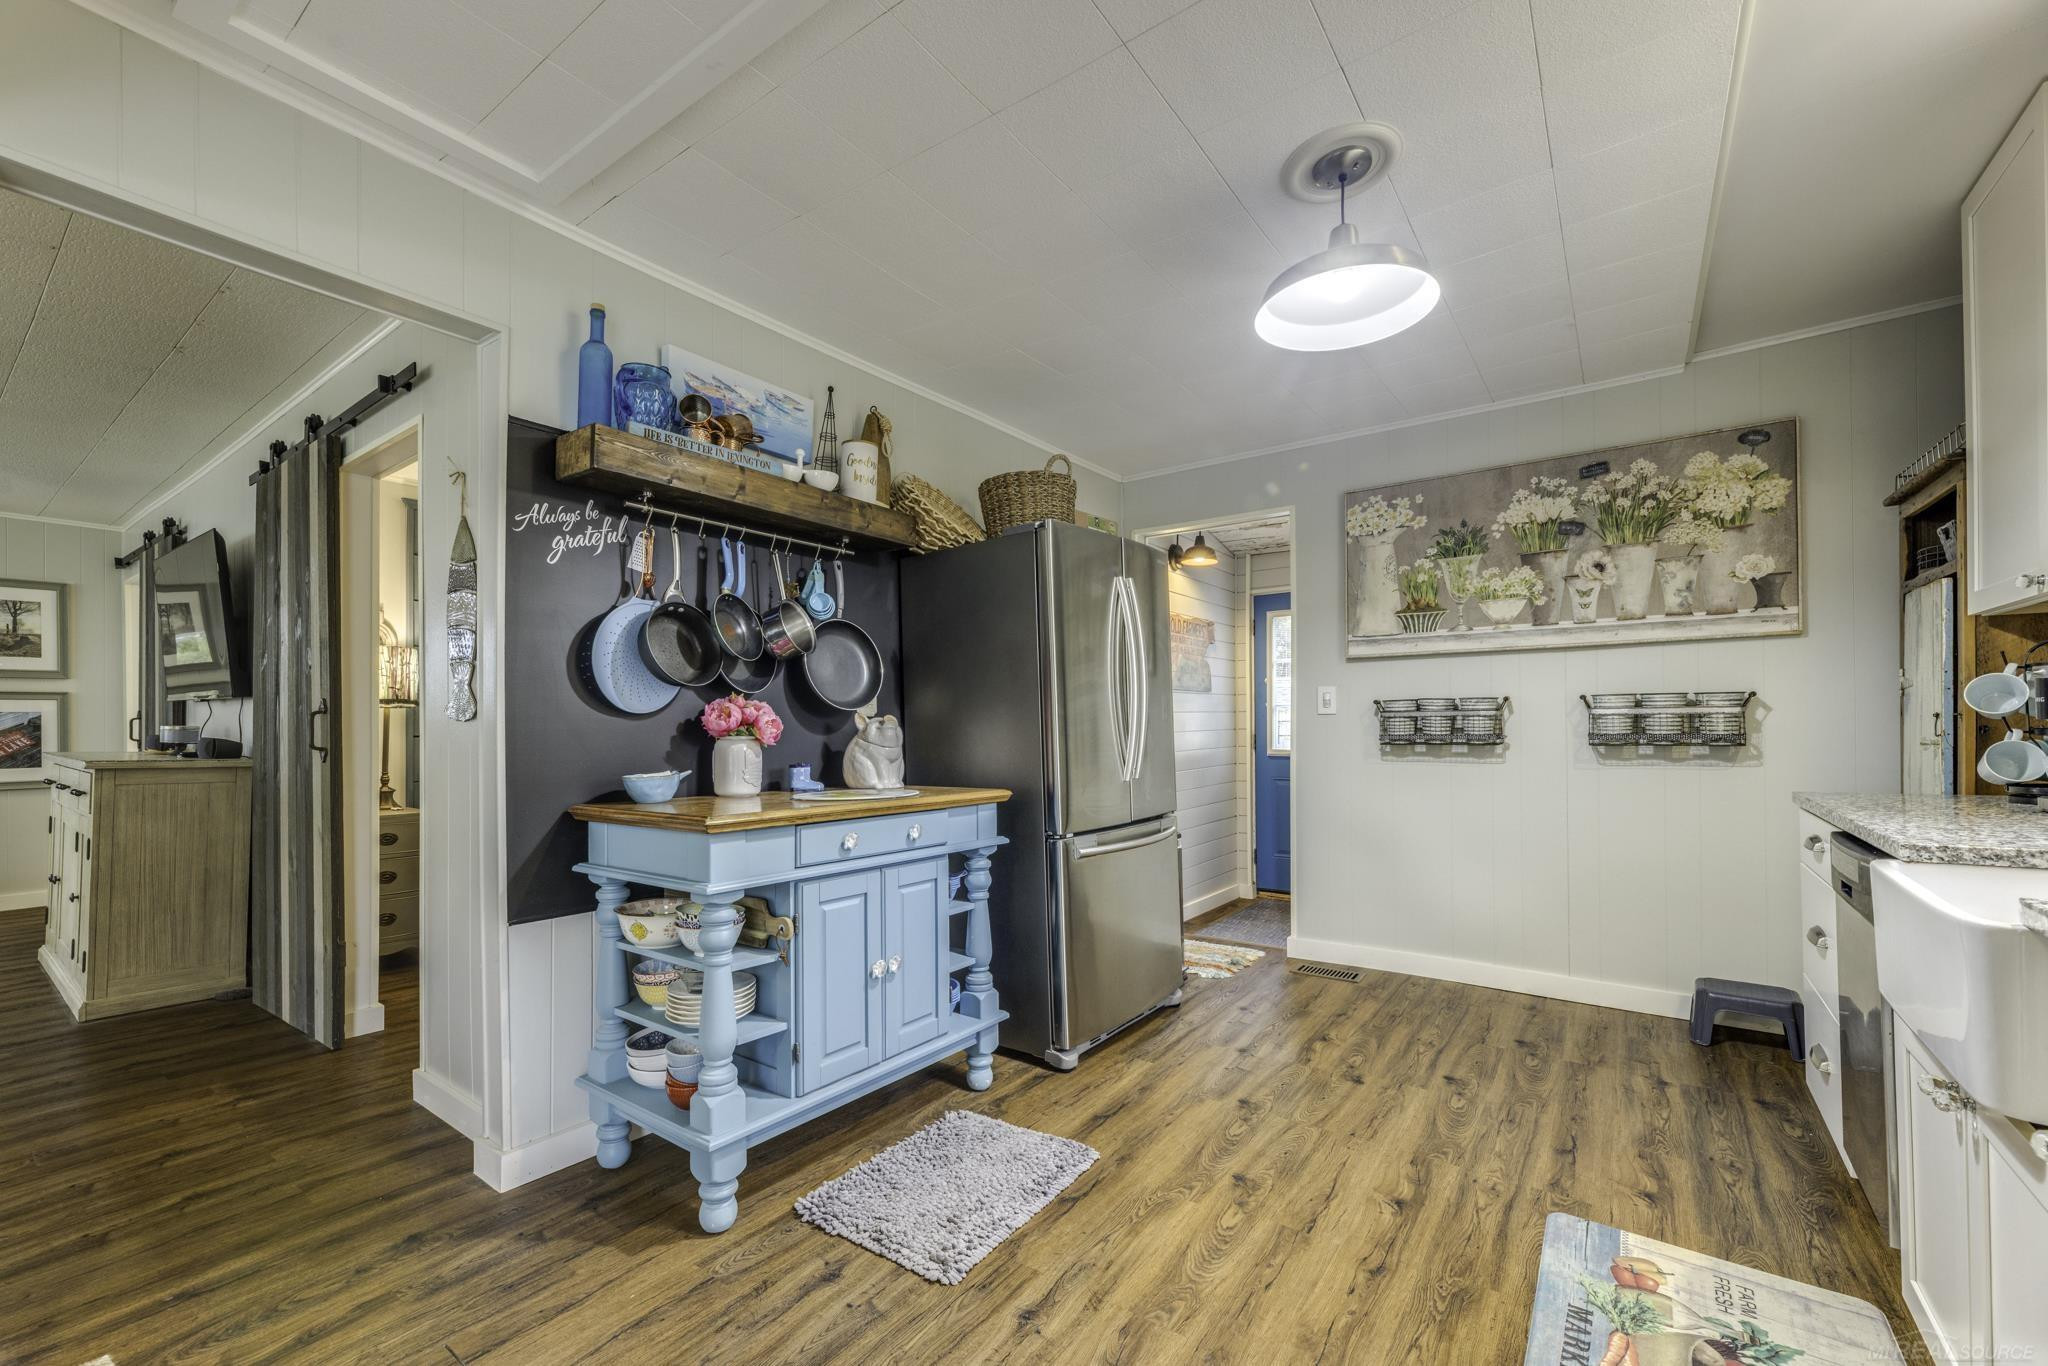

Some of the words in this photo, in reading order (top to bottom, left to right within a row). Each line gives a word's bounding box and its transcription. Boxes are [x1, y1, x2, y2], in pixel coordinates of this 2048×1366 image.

[665, 433, 674, 445] IS
[675, 436, 713, 455] BETTER
[715, 447, 725, 458] IN
[512, 502, 581, 532] Always
[585, 499, 600, 521] be
[546, 514, 629, 565] grateful
[1712, 1274, 1736, 1316] FRESH
[1736, 1283, 1759, 1320] FARM
[1560, 1303, 1593, 1366] MARK
